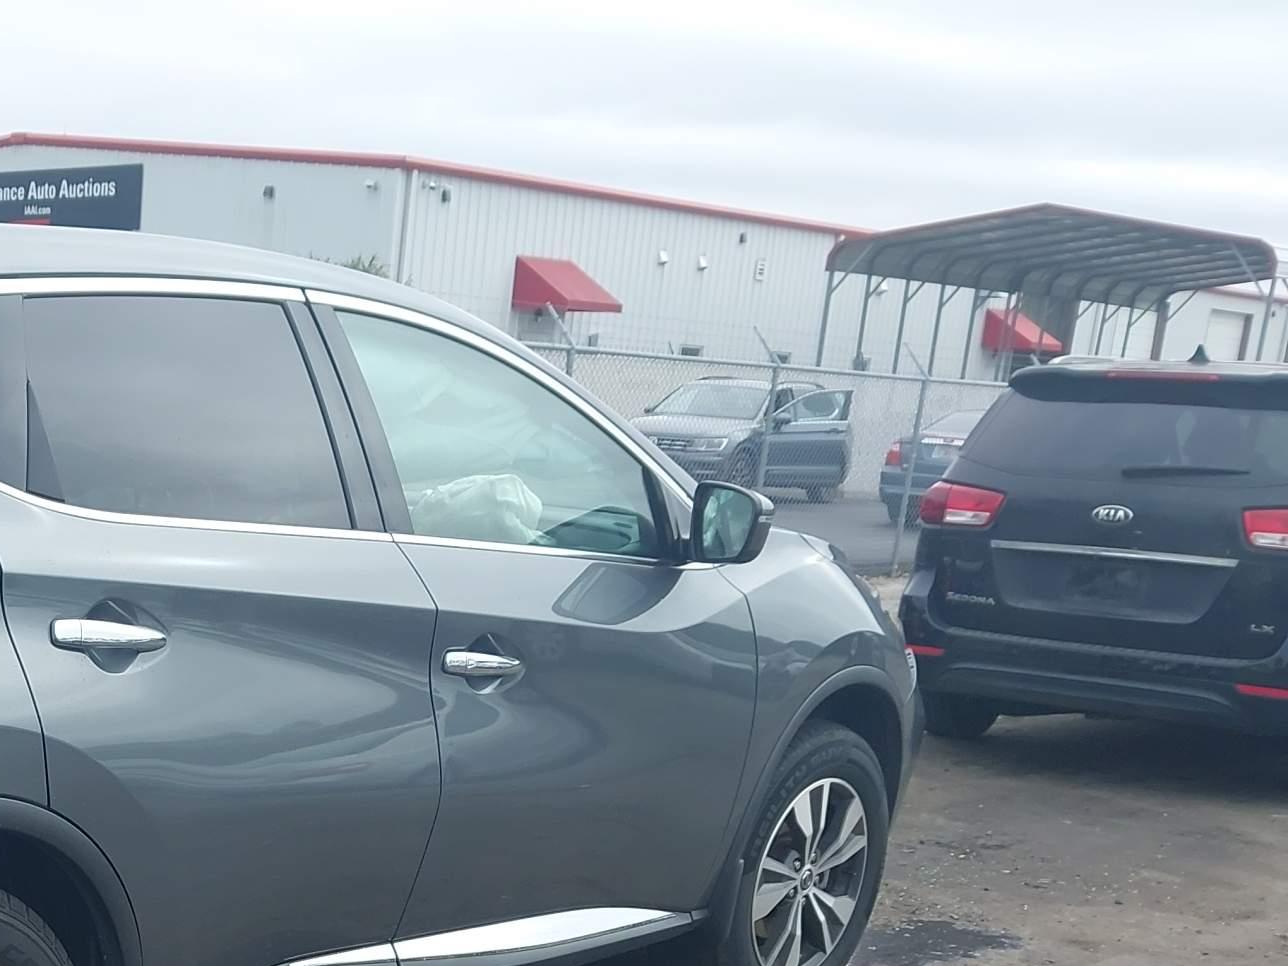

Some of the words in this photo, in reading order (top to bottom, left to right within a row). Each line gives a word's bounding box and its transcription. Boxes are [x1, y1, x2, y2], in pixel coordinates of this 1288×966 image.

[27, 180, 56, 200] Auto
[59, 178, 116, 199] Auctions
[1097, 508, 1125, 521] KIA
